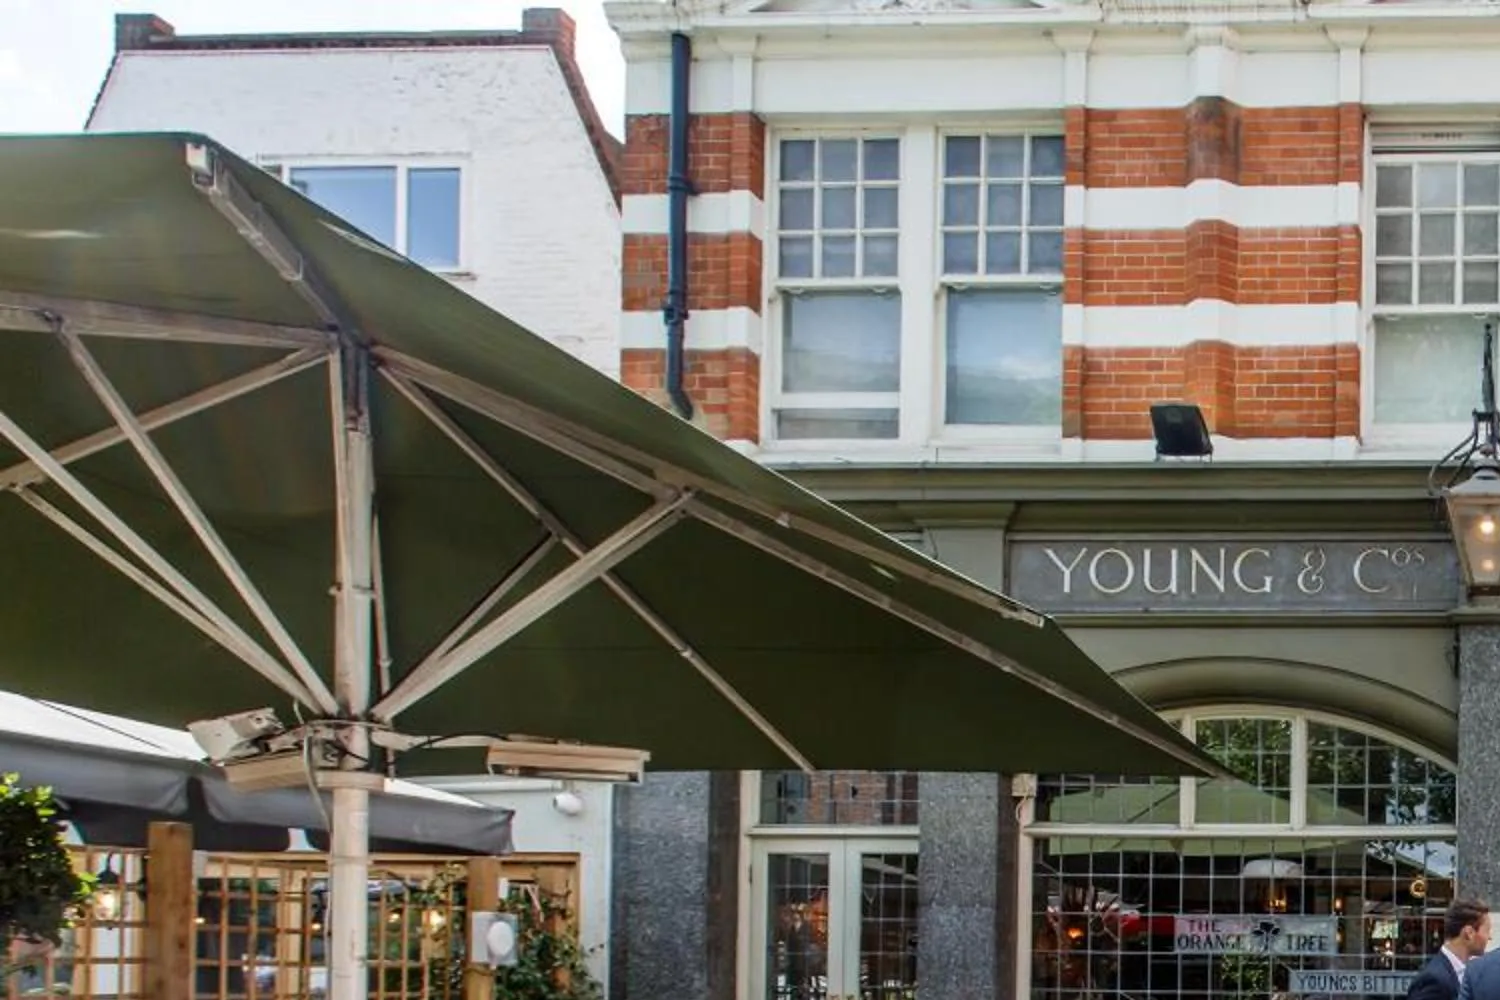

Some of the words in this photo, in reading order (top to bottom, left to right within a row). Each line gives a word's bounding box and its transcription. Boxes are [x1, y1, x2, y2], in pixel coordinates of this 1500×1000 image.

[1043, 547, 1273, 594] YOUNG
[1297, 547, 1327, 595] &
[1187, 918, 1221, 933] THE
[1176, 932, 1247, 951] ORANGE
[1285, 932, 1330, 951] TREE
[1362, 975, 1412, 992] BITTE
